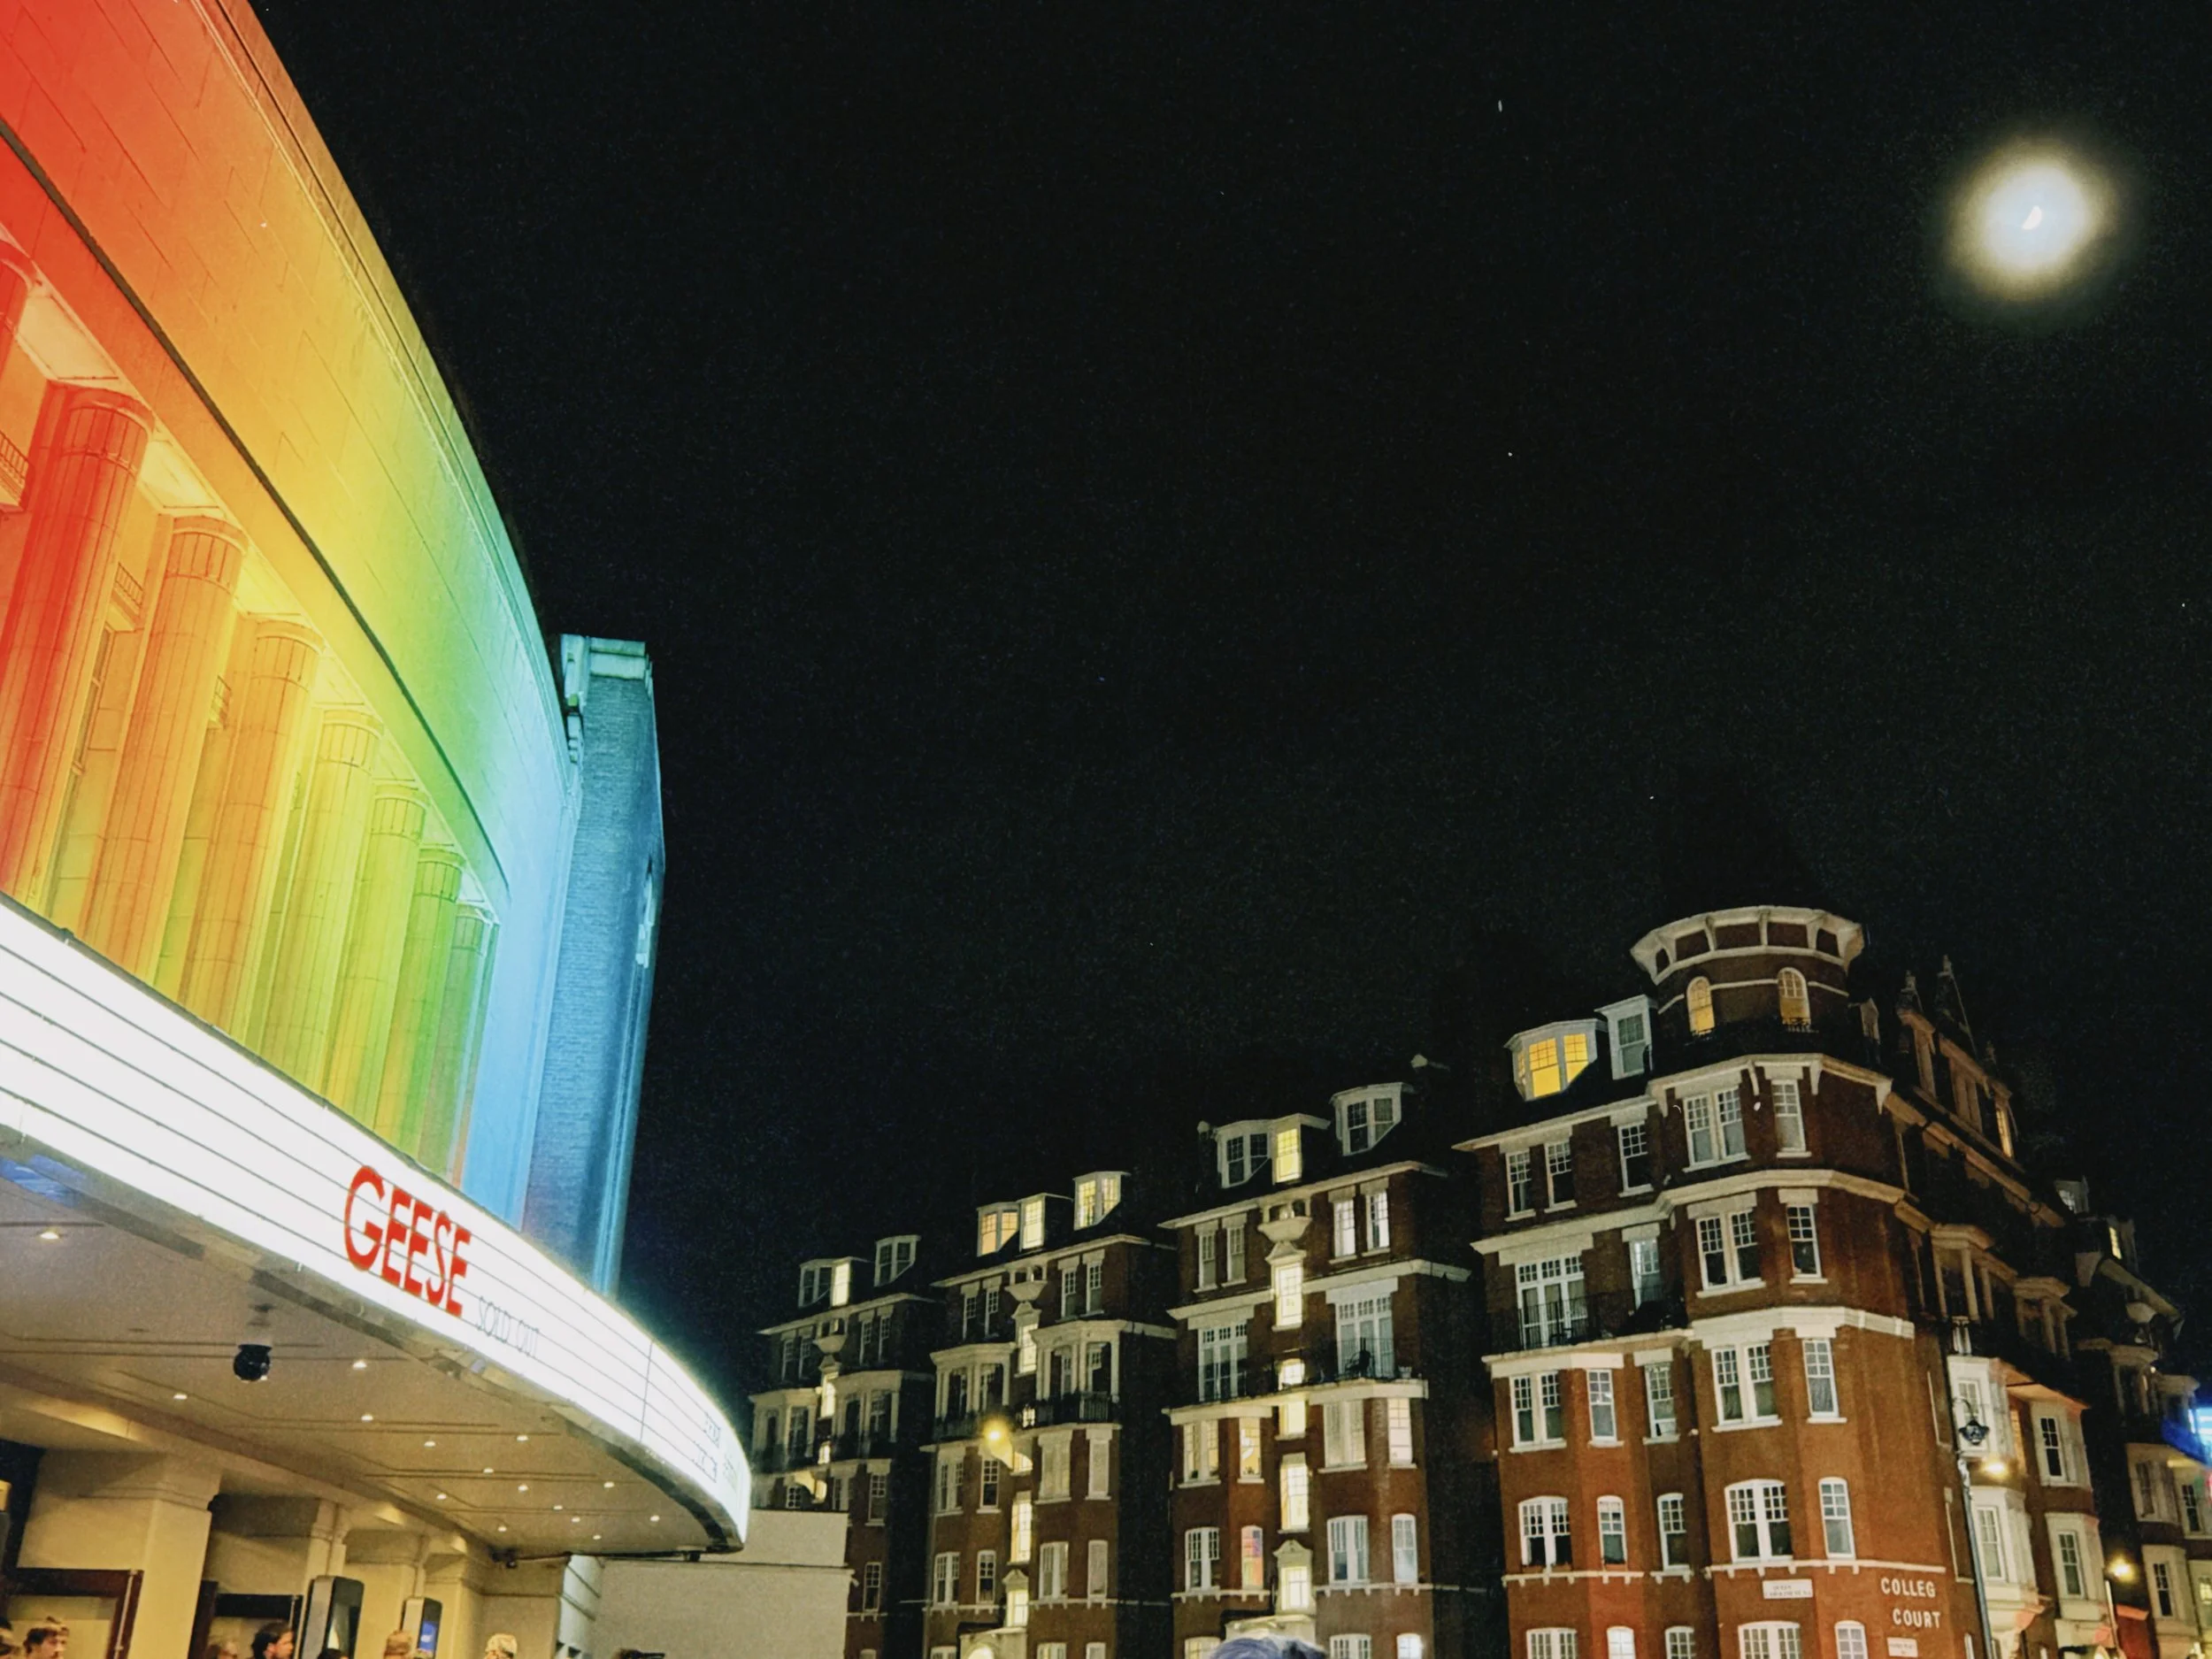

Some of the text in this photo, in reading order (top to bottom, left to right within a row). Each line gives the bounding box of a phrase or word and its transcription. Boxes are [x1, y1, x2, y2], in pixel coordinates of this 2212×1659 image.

[344, 1164, 472, 1318] GEESE
[1880, 1577, 1936, 1599] COLLEG
[1892, 1608, 1941, 1629] COURT
